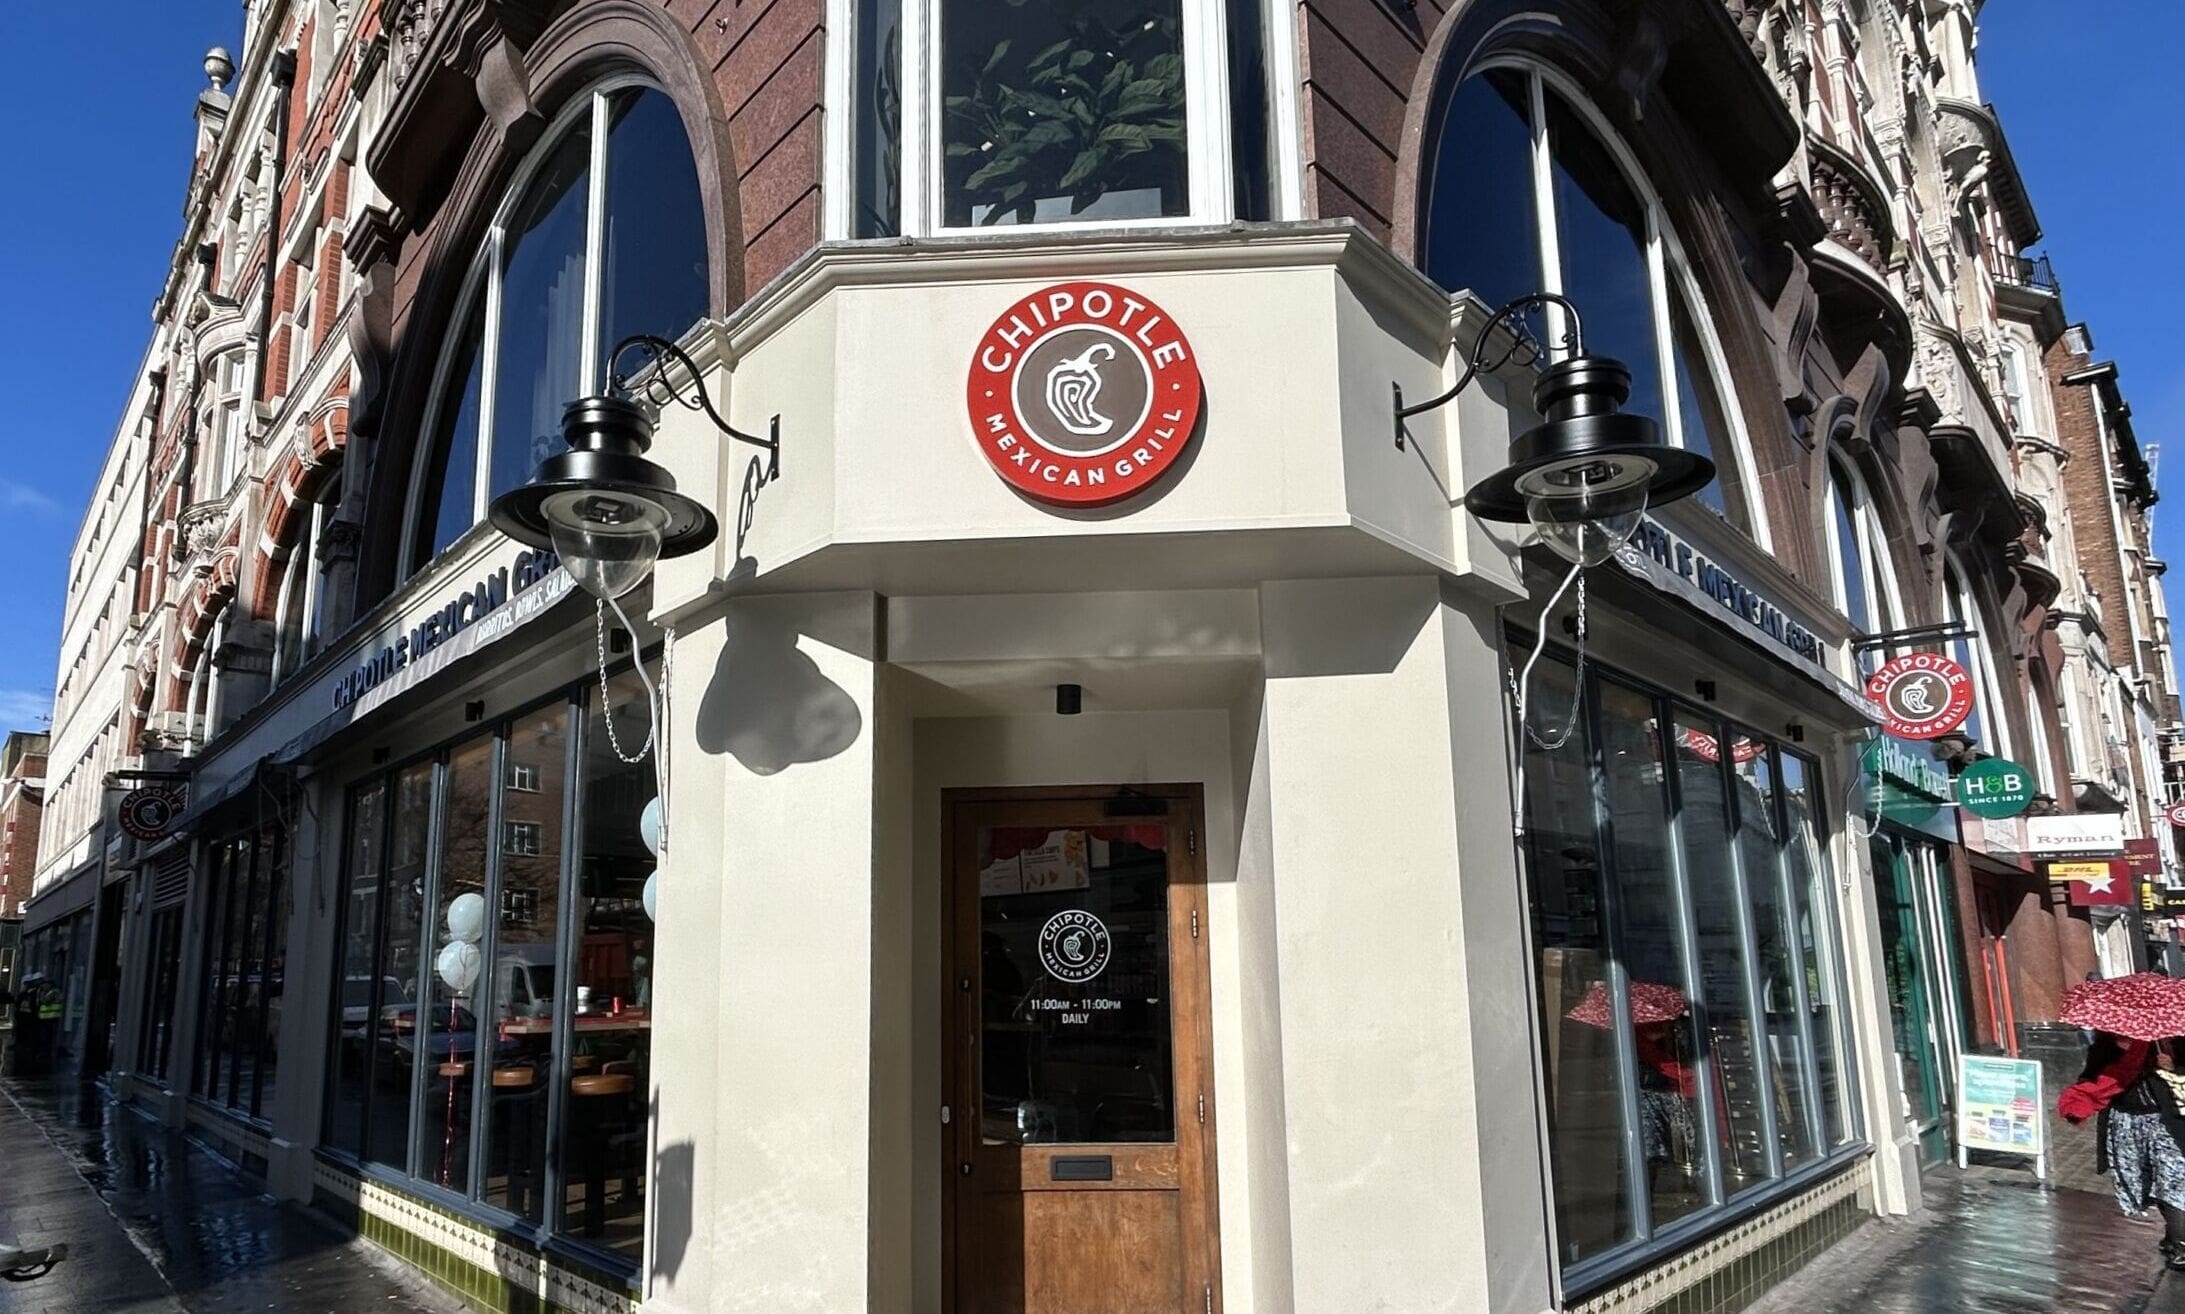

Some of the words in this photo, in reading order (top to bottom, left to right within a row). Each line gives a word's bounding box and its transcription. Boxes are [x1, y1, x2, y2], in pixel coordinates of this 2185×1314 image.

[981, 289, 1187, 373] CHIPOTLE
[986, 413, 1105, 486] MEXICAN
[1115, 408, 1182, 477] GRILL
[332, 635, 409, 710] CHIPOTLE
[410, 566, 508, 665] MEXICAN
[1871, 655, 1966, 693] CHIPOTLE
[1935, 699, 1966, 729] GRILL
[1965, 773, 2022, 795] H&B
[122, 787, 182, 812] CHIPOTLE
[1968, 796, 1998, 805] SINCE
[2001, 794, 2024, 803] 1870
[2036, 834, 2115, 845] Ryman
[1044, 913, 1106, 941] CHIPOTLE
[1045, 952, 1082, 977] MEXICAN
[1083, 952, 1105, 975] GRILL
[1031, 998, 1070, 1010] 11:00AM
[1081, 998, 1121, 1010] 11:00PM
[1061, 1013, 1089, 1024] DAILY
